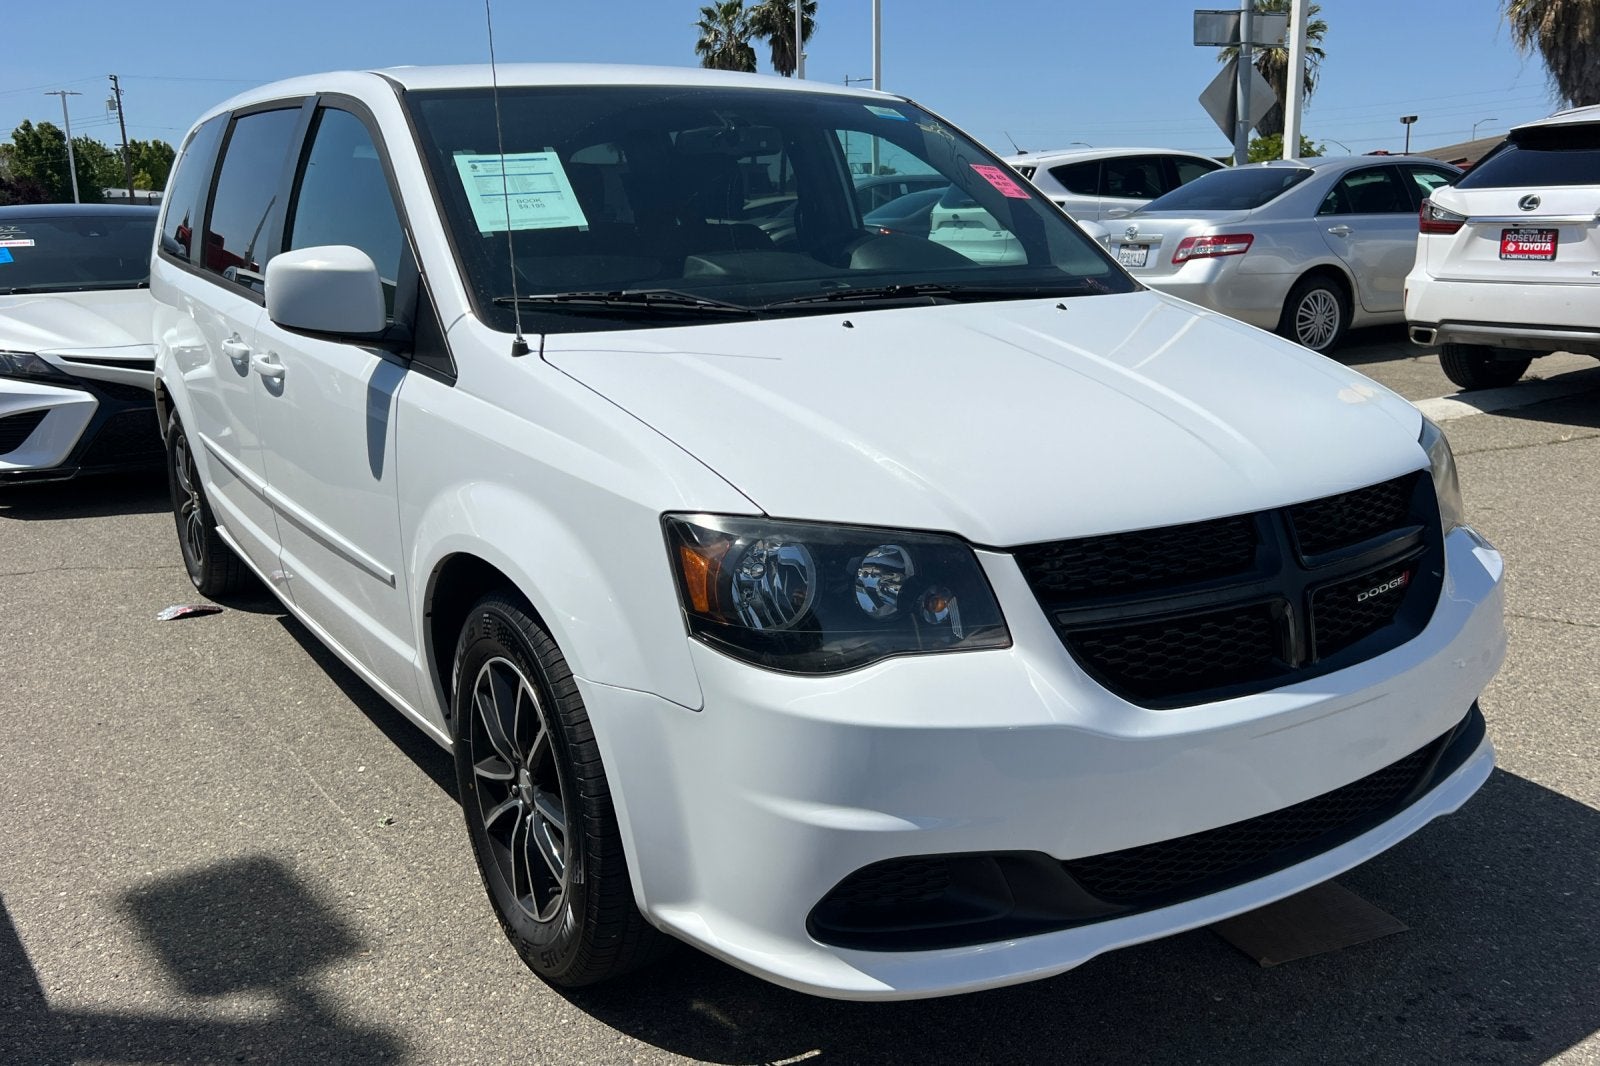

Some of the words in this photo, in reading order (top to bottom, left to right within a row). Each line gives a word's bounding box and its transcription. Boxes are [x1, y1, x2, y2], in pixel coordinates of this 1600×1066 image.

[1506, 234, 1552, 242] ROSEVILLE
[1518, 243, 1551, 251] TOYOTA
[1357, 575, 1405, 602] DODGE
